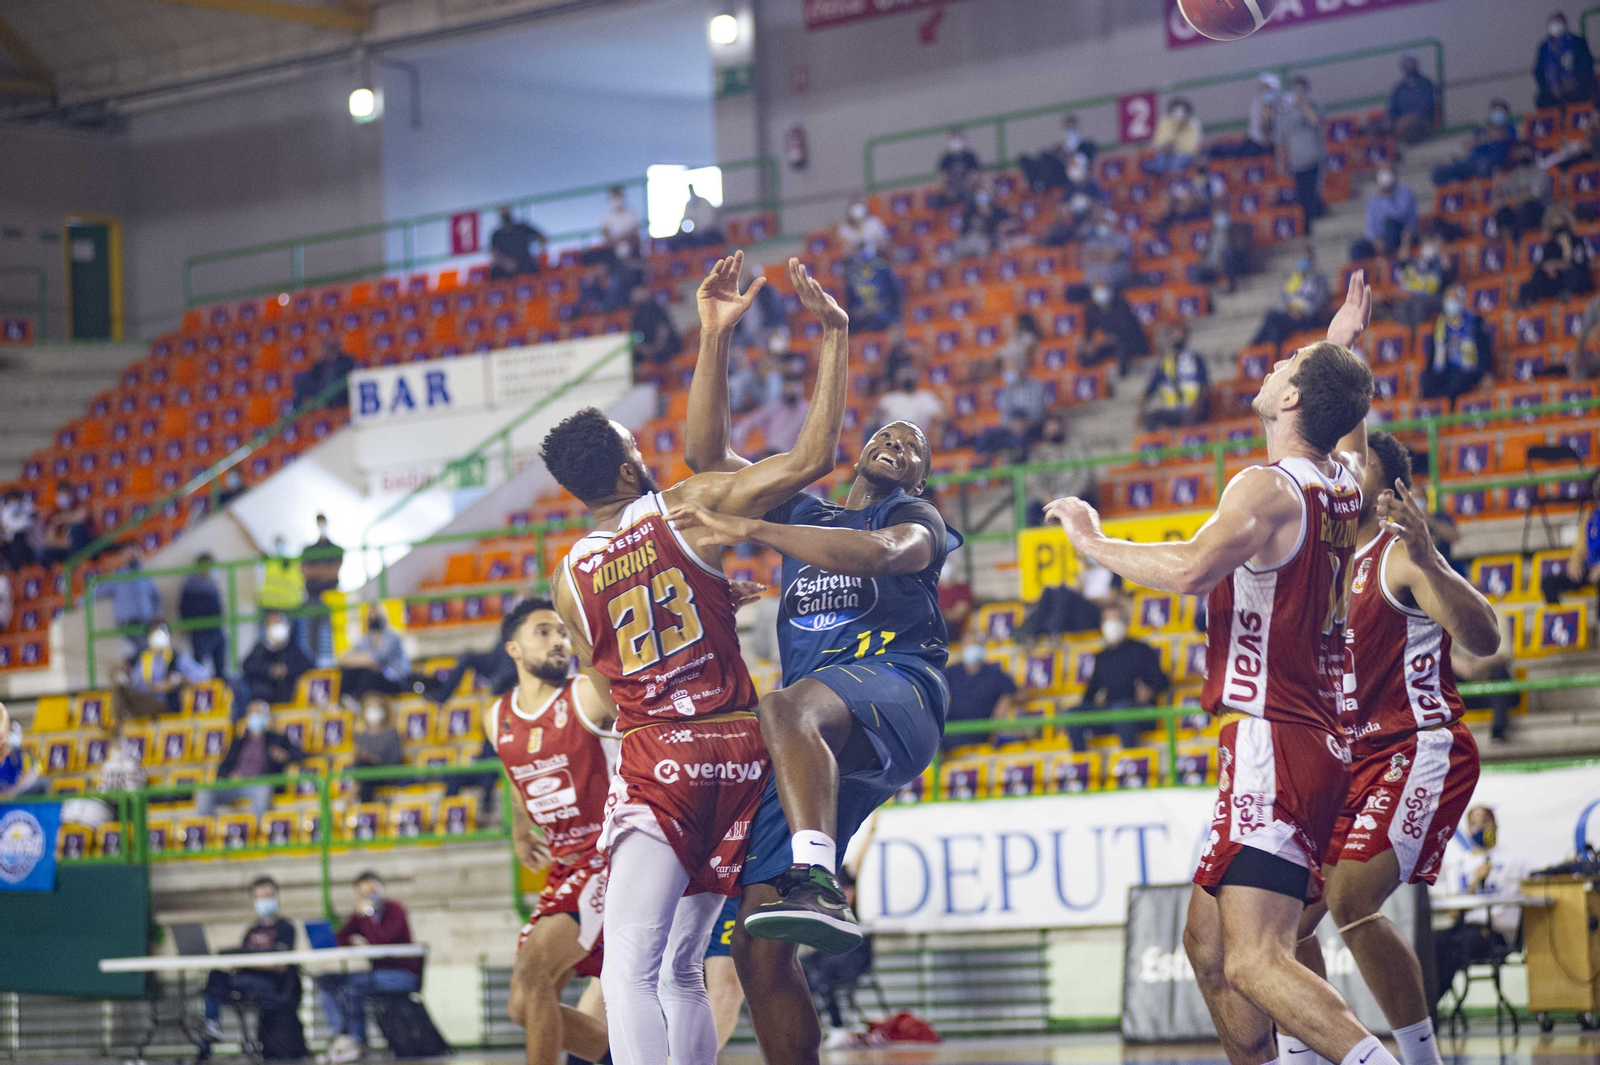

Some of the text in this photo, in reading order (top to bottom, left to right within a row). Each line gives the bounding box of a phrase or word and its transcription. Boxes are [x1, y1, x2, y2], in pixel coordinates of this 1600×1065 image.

[1126, 98, 1150, 138] 2
[358, 370, 452, 416] BAR
[593, 539, 659, 595] NORRIS
[794, 573, 863, 597] Estrella
[797, 589, 860, 616] Galicia
[607, 566, 705, 677] 23
[854, 630, 896, 660] 11
[655, 652, 715, 684] Ayuntamiento
[669, 671, 701, 688] Murcia
[691, 693, 702, 701] de
